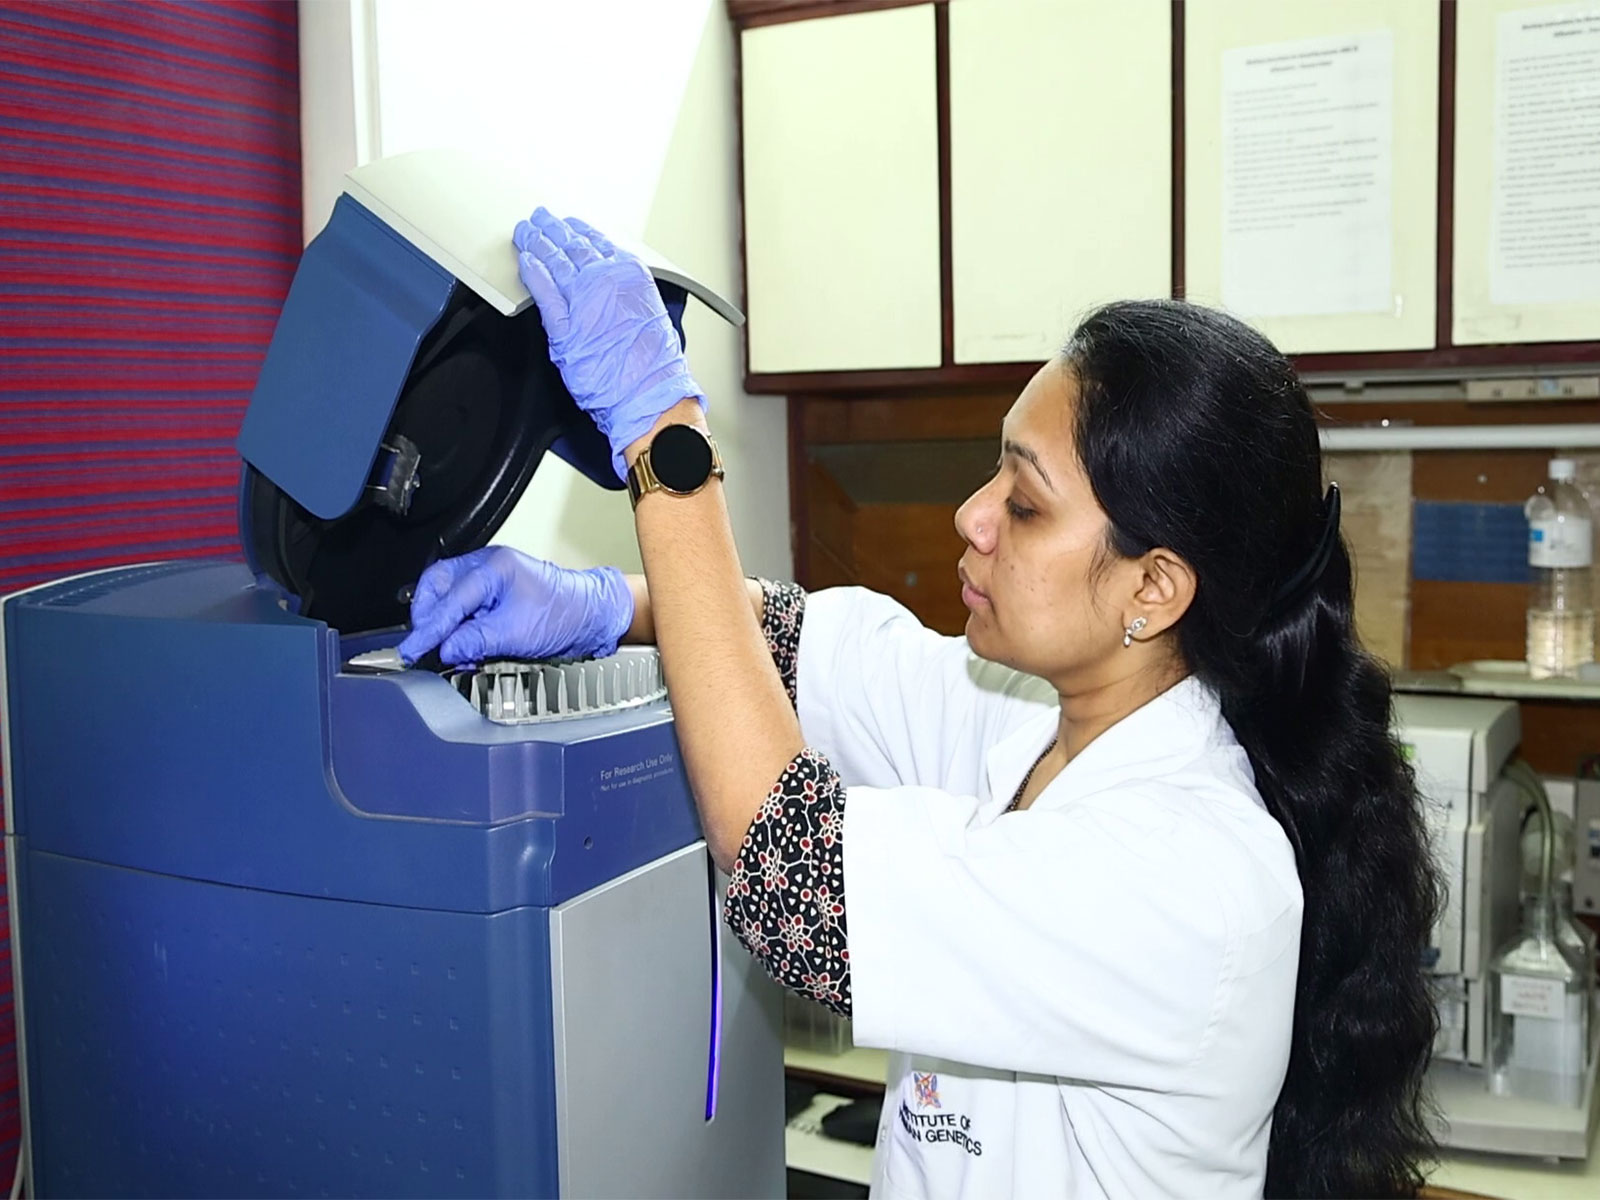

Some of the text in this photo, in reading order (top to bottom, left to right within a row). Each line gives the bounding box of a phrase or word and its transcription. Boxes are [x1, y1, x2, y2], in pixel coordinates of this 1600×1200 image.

[600, 753, 673, 781] For Research Use Only
[902, 1099, 971, 1131] TITUTE OF
[925, 1129, 982, 1156] GENETICS
